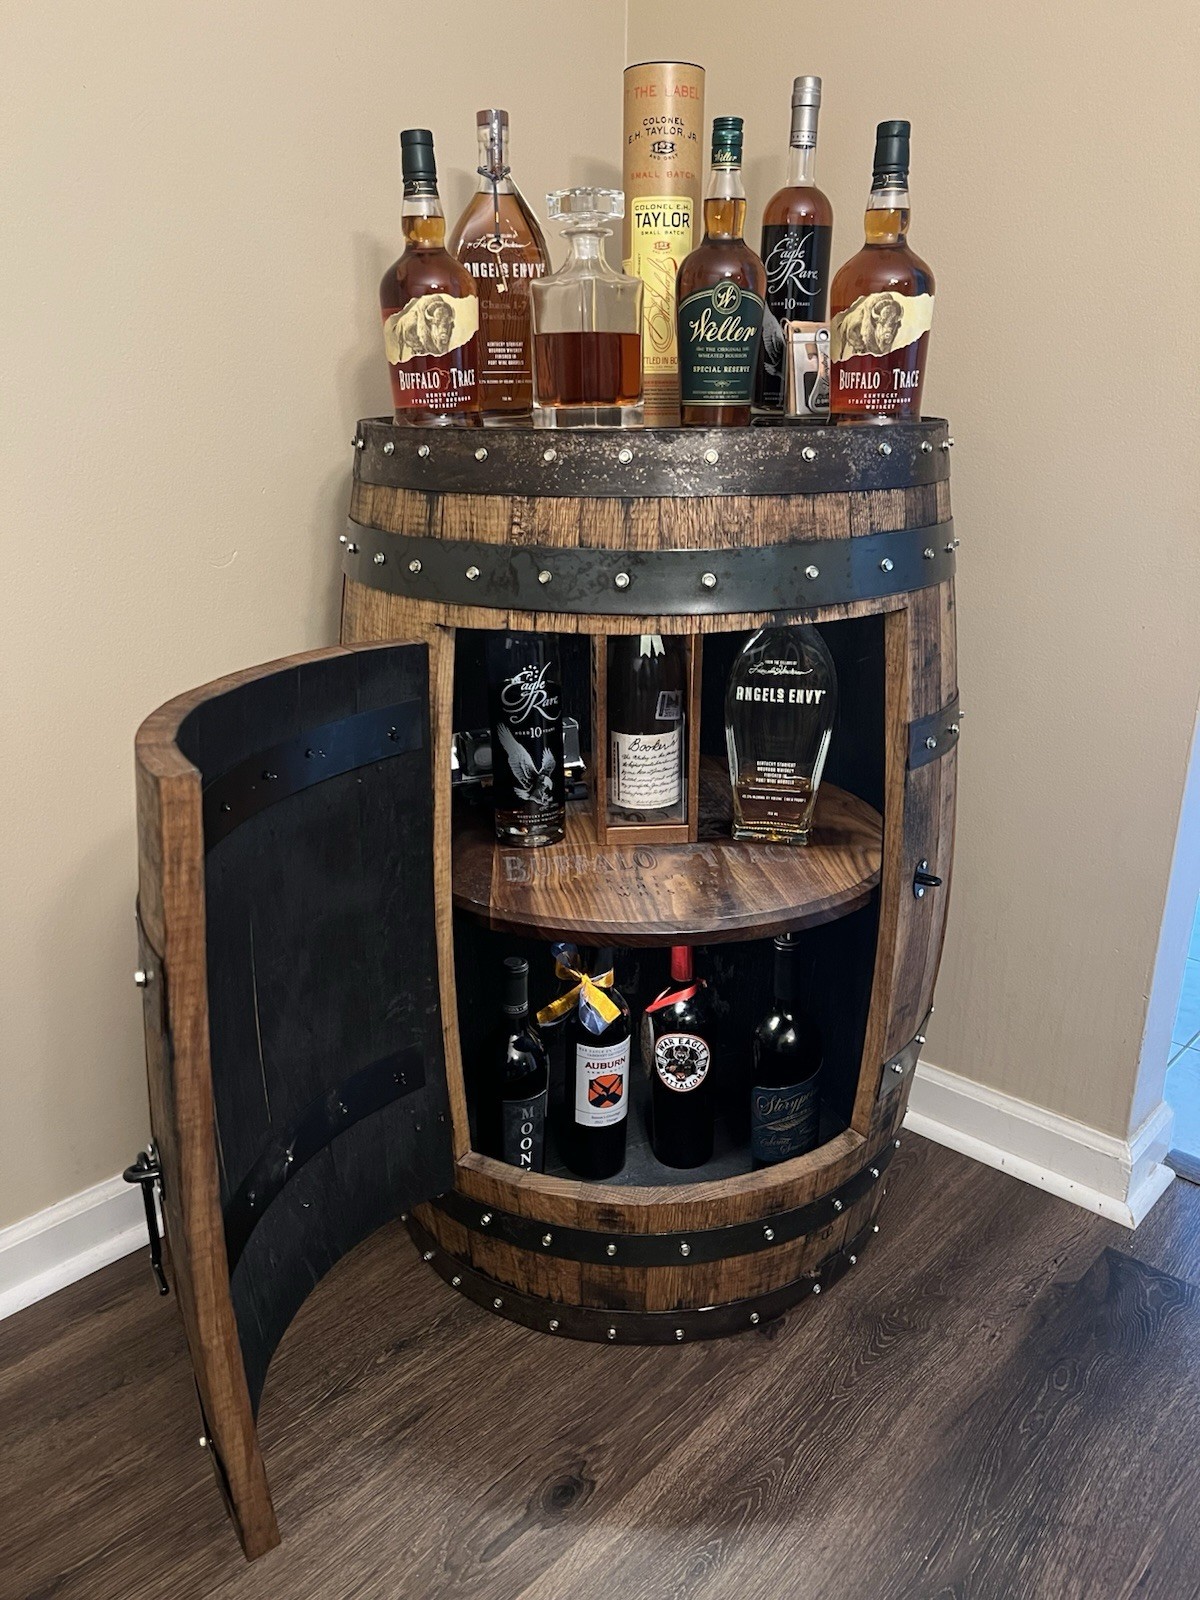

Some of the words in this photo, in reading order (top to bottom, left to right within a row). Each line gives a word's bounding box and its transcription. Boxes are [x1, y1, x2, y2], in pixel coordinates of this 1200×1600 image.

[634, 85, 657, 99] THE
[665, 85, 700, 100] LABEL
[643, 116, 685, 126] COLONEL
[628, 131, 643, 145] E.H.
[631, 171, 659, 180] SMALL
[666, 171, 695, 179] BATCH
[635, 212, 690, 228] TAYLOR
[512, 263, 545, 278] ENVY
[784, 297, 796, 310] 10
[689, 308, 758, 342] Weller
[662, 357, 669, 365] IN
[399, 369, 440, 391] BUFFALO
[450, 368, 475, 389] TRACE
[839, 369, 880, 390] BUFFALO
[893, 368, 920, 390] TRACE
[736, 686, 785, 703] ANGELS
[788, 688, 823, 705] ENVY
[530, 726, 542, 739] 10
[628, 734, 679, 752] Booker's
[503, 850, 658, 883] BUFFALO
[658, 1039, 675, 1051] WAR
[679, 1038, 706, 1055] EAGLE
[585, 1056, 626, 1069] AUBURN
[660, 1066, 705, 1089] BATTALION
